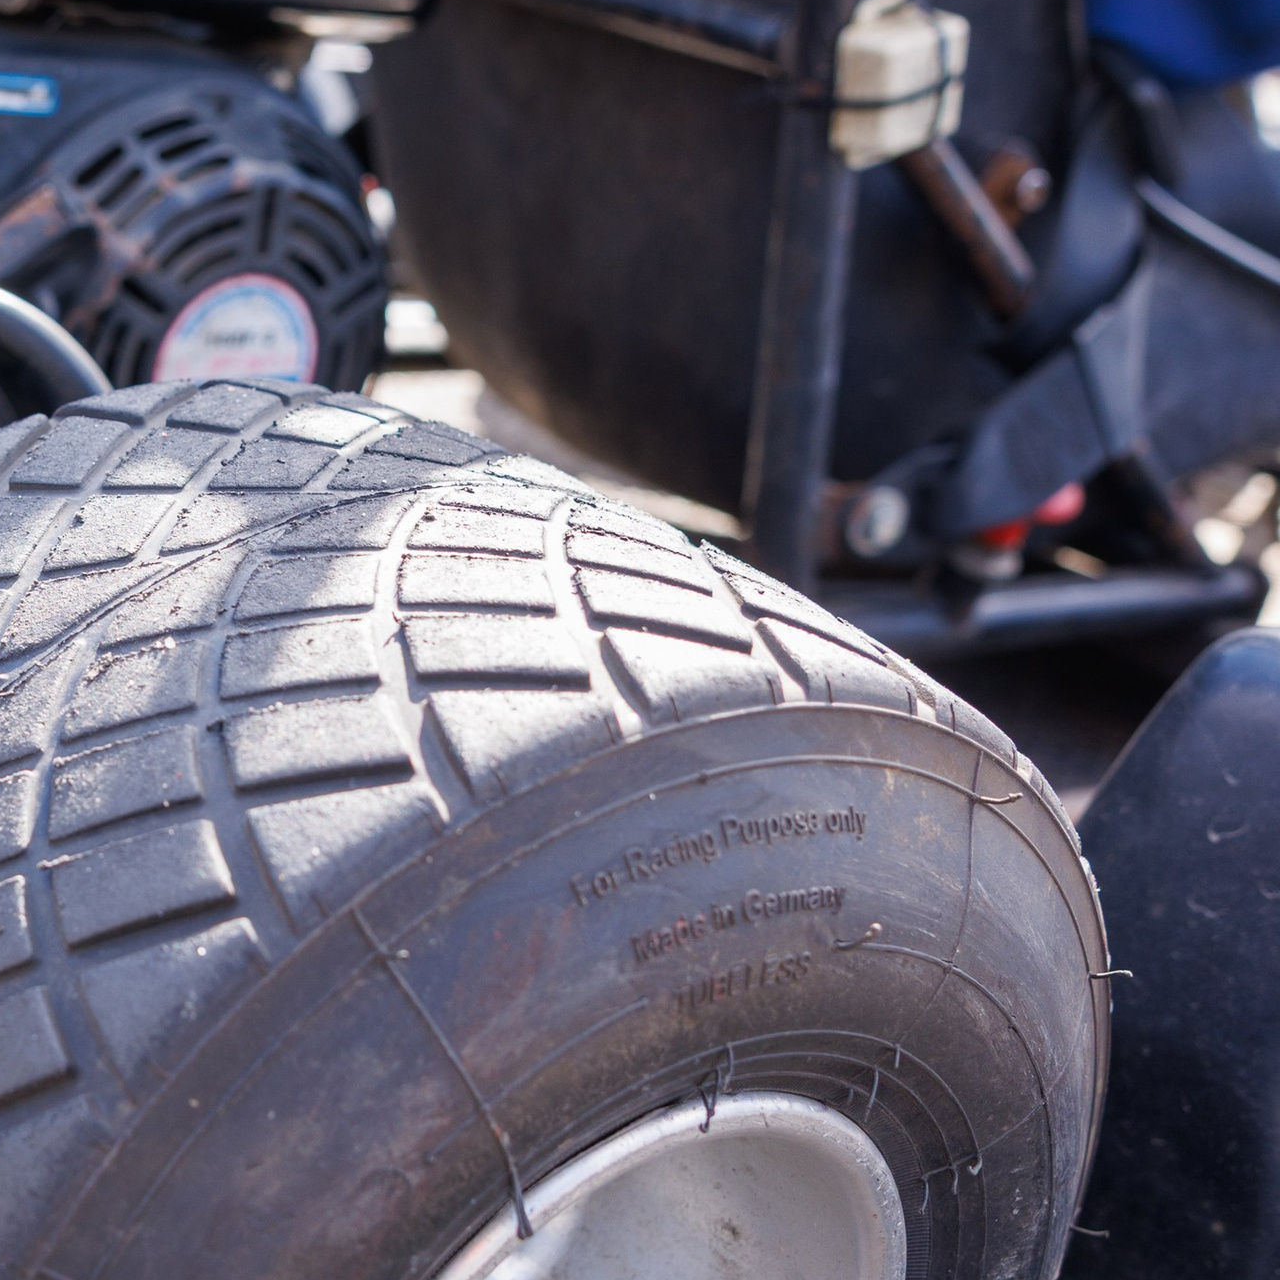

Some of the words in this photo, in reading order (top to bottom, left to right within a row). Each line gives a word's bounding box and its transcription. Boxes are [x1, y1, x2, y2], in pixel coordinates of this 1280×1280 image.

[571, 872, 620, 907] For
[624, 828, 718, 883] Racing
[719, 811, 818, 849] Purpose
[821, 804, 867, 842] only
[630, 915, 707, 964] Made
[712, 901, 736, 930] in
[741, 883, 847, 920] Germany
